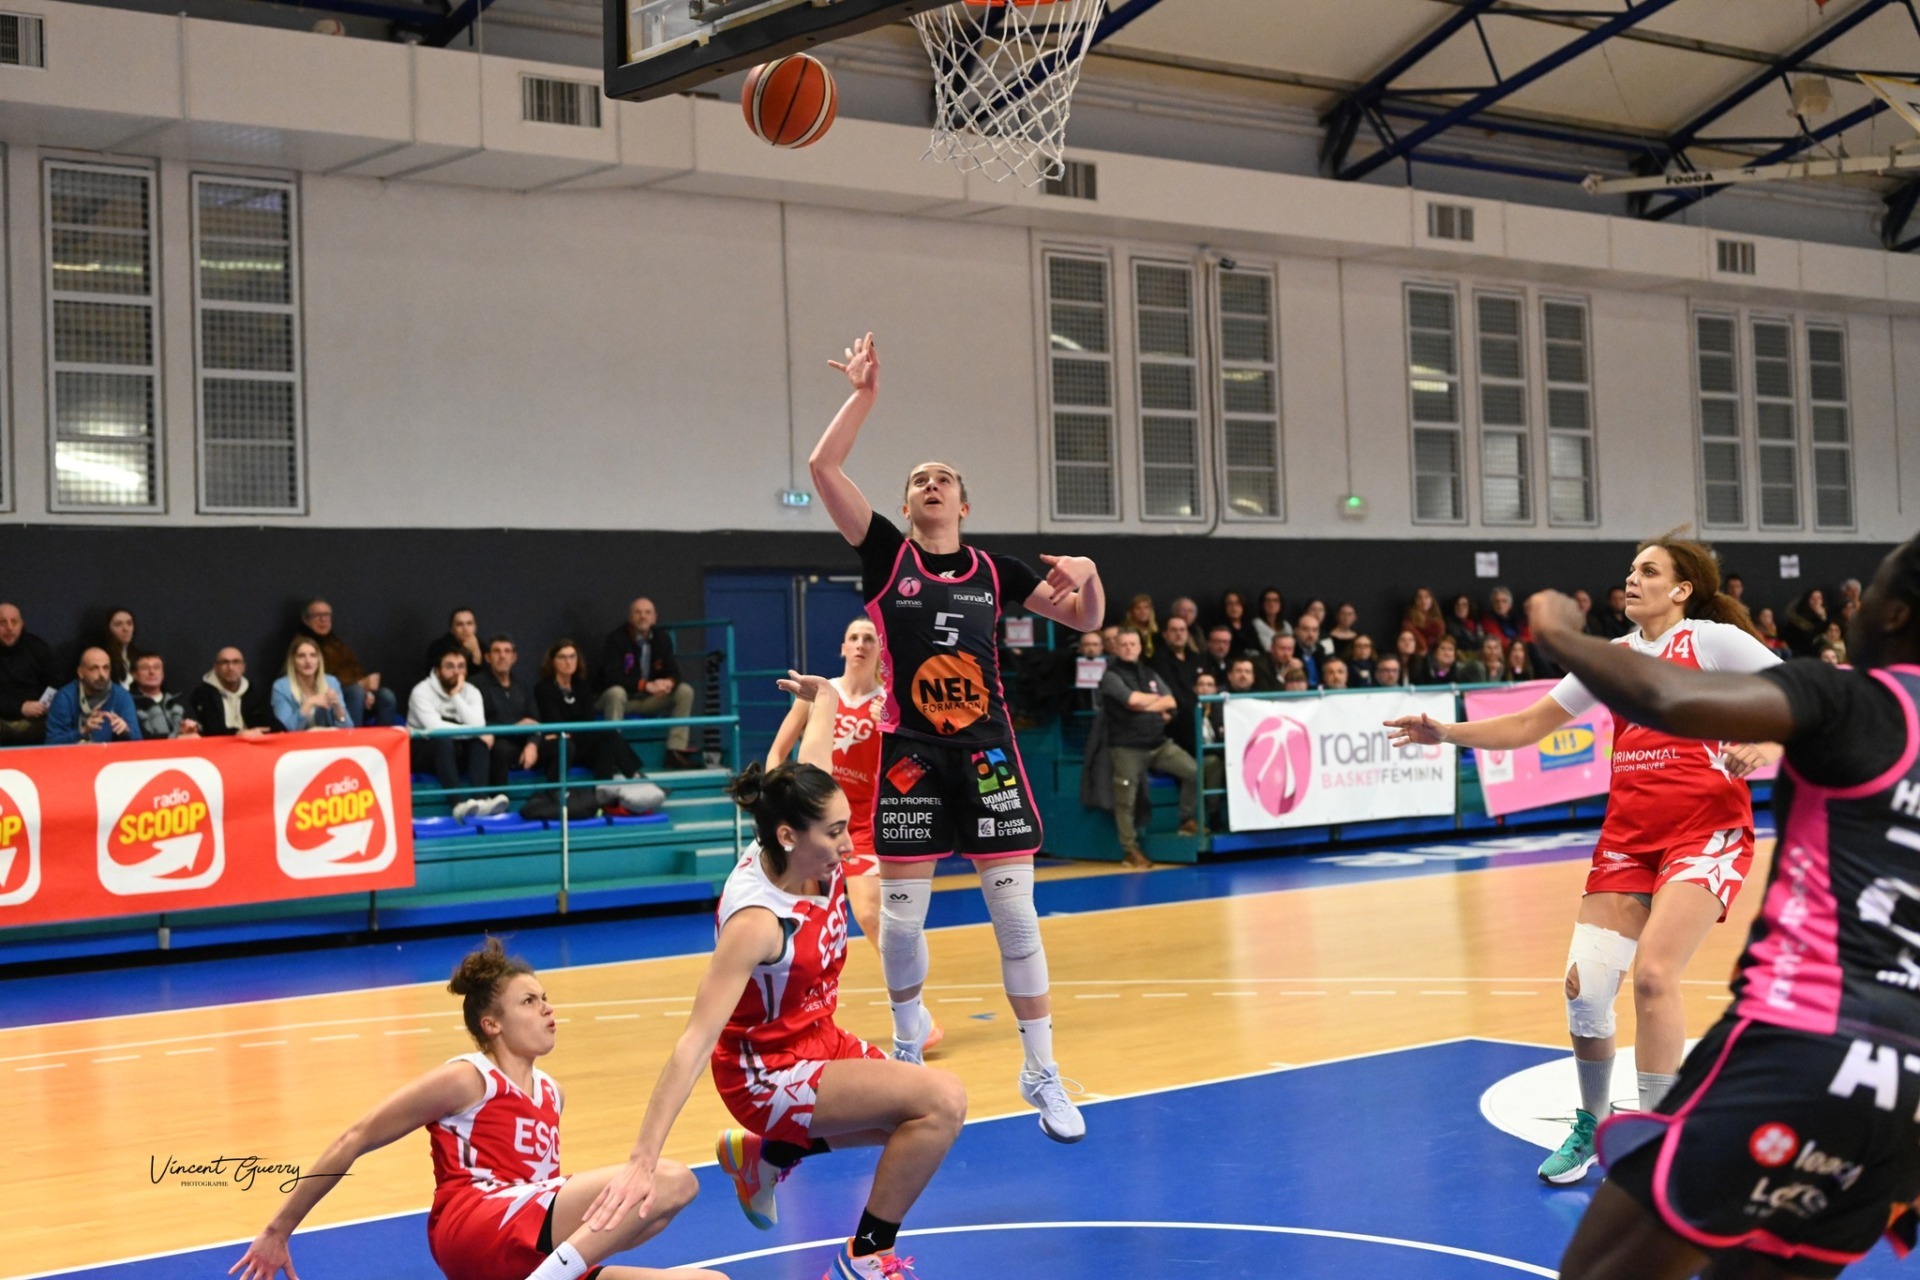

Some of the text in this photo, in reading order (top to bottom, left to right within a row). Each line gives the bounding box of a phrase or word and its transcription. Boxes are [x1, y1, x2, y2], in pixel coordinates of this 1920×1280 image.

[932, 612, 964, 646] 5
[1666, 634, 1690, 659] 14
[919, 678, 980, 704] NEL
[153, 787, 190, 810] radio
[325, 776, 359, 797] radio
[295, 789, 374, 831] SCOOP
[882, 812, 933, 824] GROUPE
[119, 802, 206, 845] SCOOP
[882, 824, 932, 839] sofirex
[997, 818, 1026, 829] CAISSE
